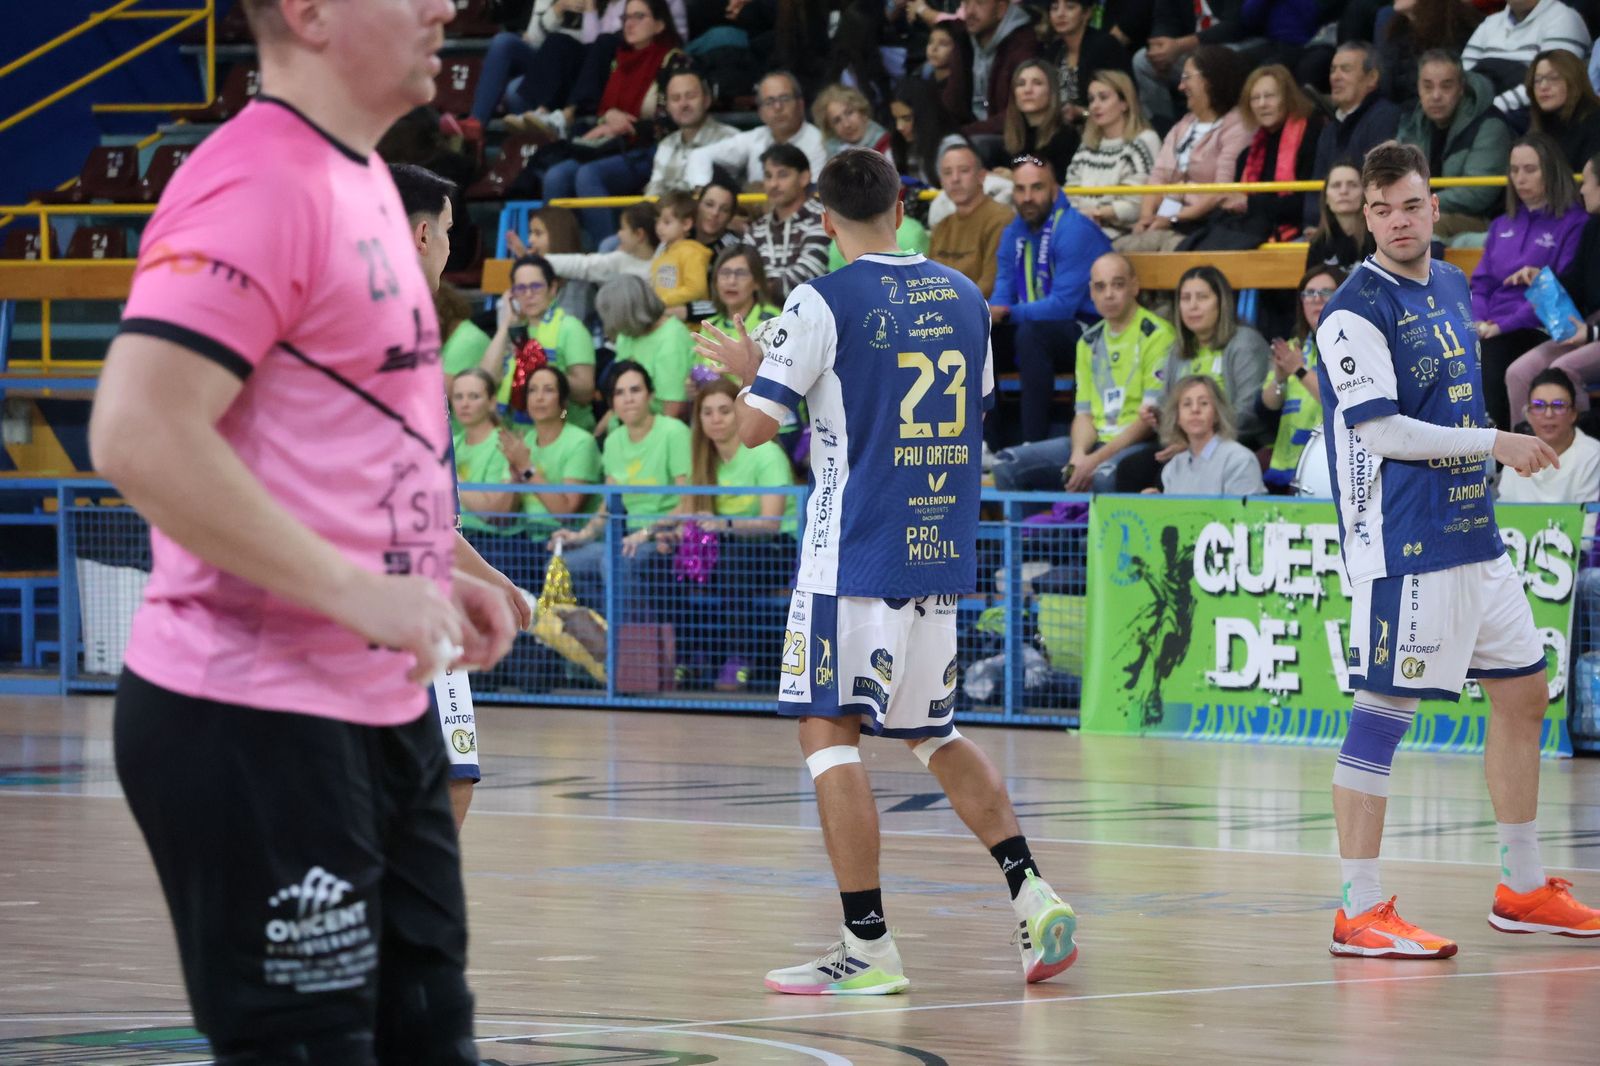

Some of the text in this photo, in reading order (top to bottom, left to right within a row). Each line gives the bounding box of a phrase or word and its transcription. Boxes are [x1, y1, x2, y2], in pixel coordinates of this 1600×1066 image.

[907, 288, 960, 305] ZAMORA
[908, 324, 954, 339] sangregorio
[1433, 321, 1465, 359] 11
[898, 350, 966, 438] 23
[1448, 382, 1472, 403] gaza
[894, 445, 969, 466] PAU ORTEGA
[908, 495, 956, 506] MOLENDUM
[1448, 483, 1485, 502] ZAMORA
[906, 525, 938, 544] PRO
[1205, 616, 1300, 690] DE
